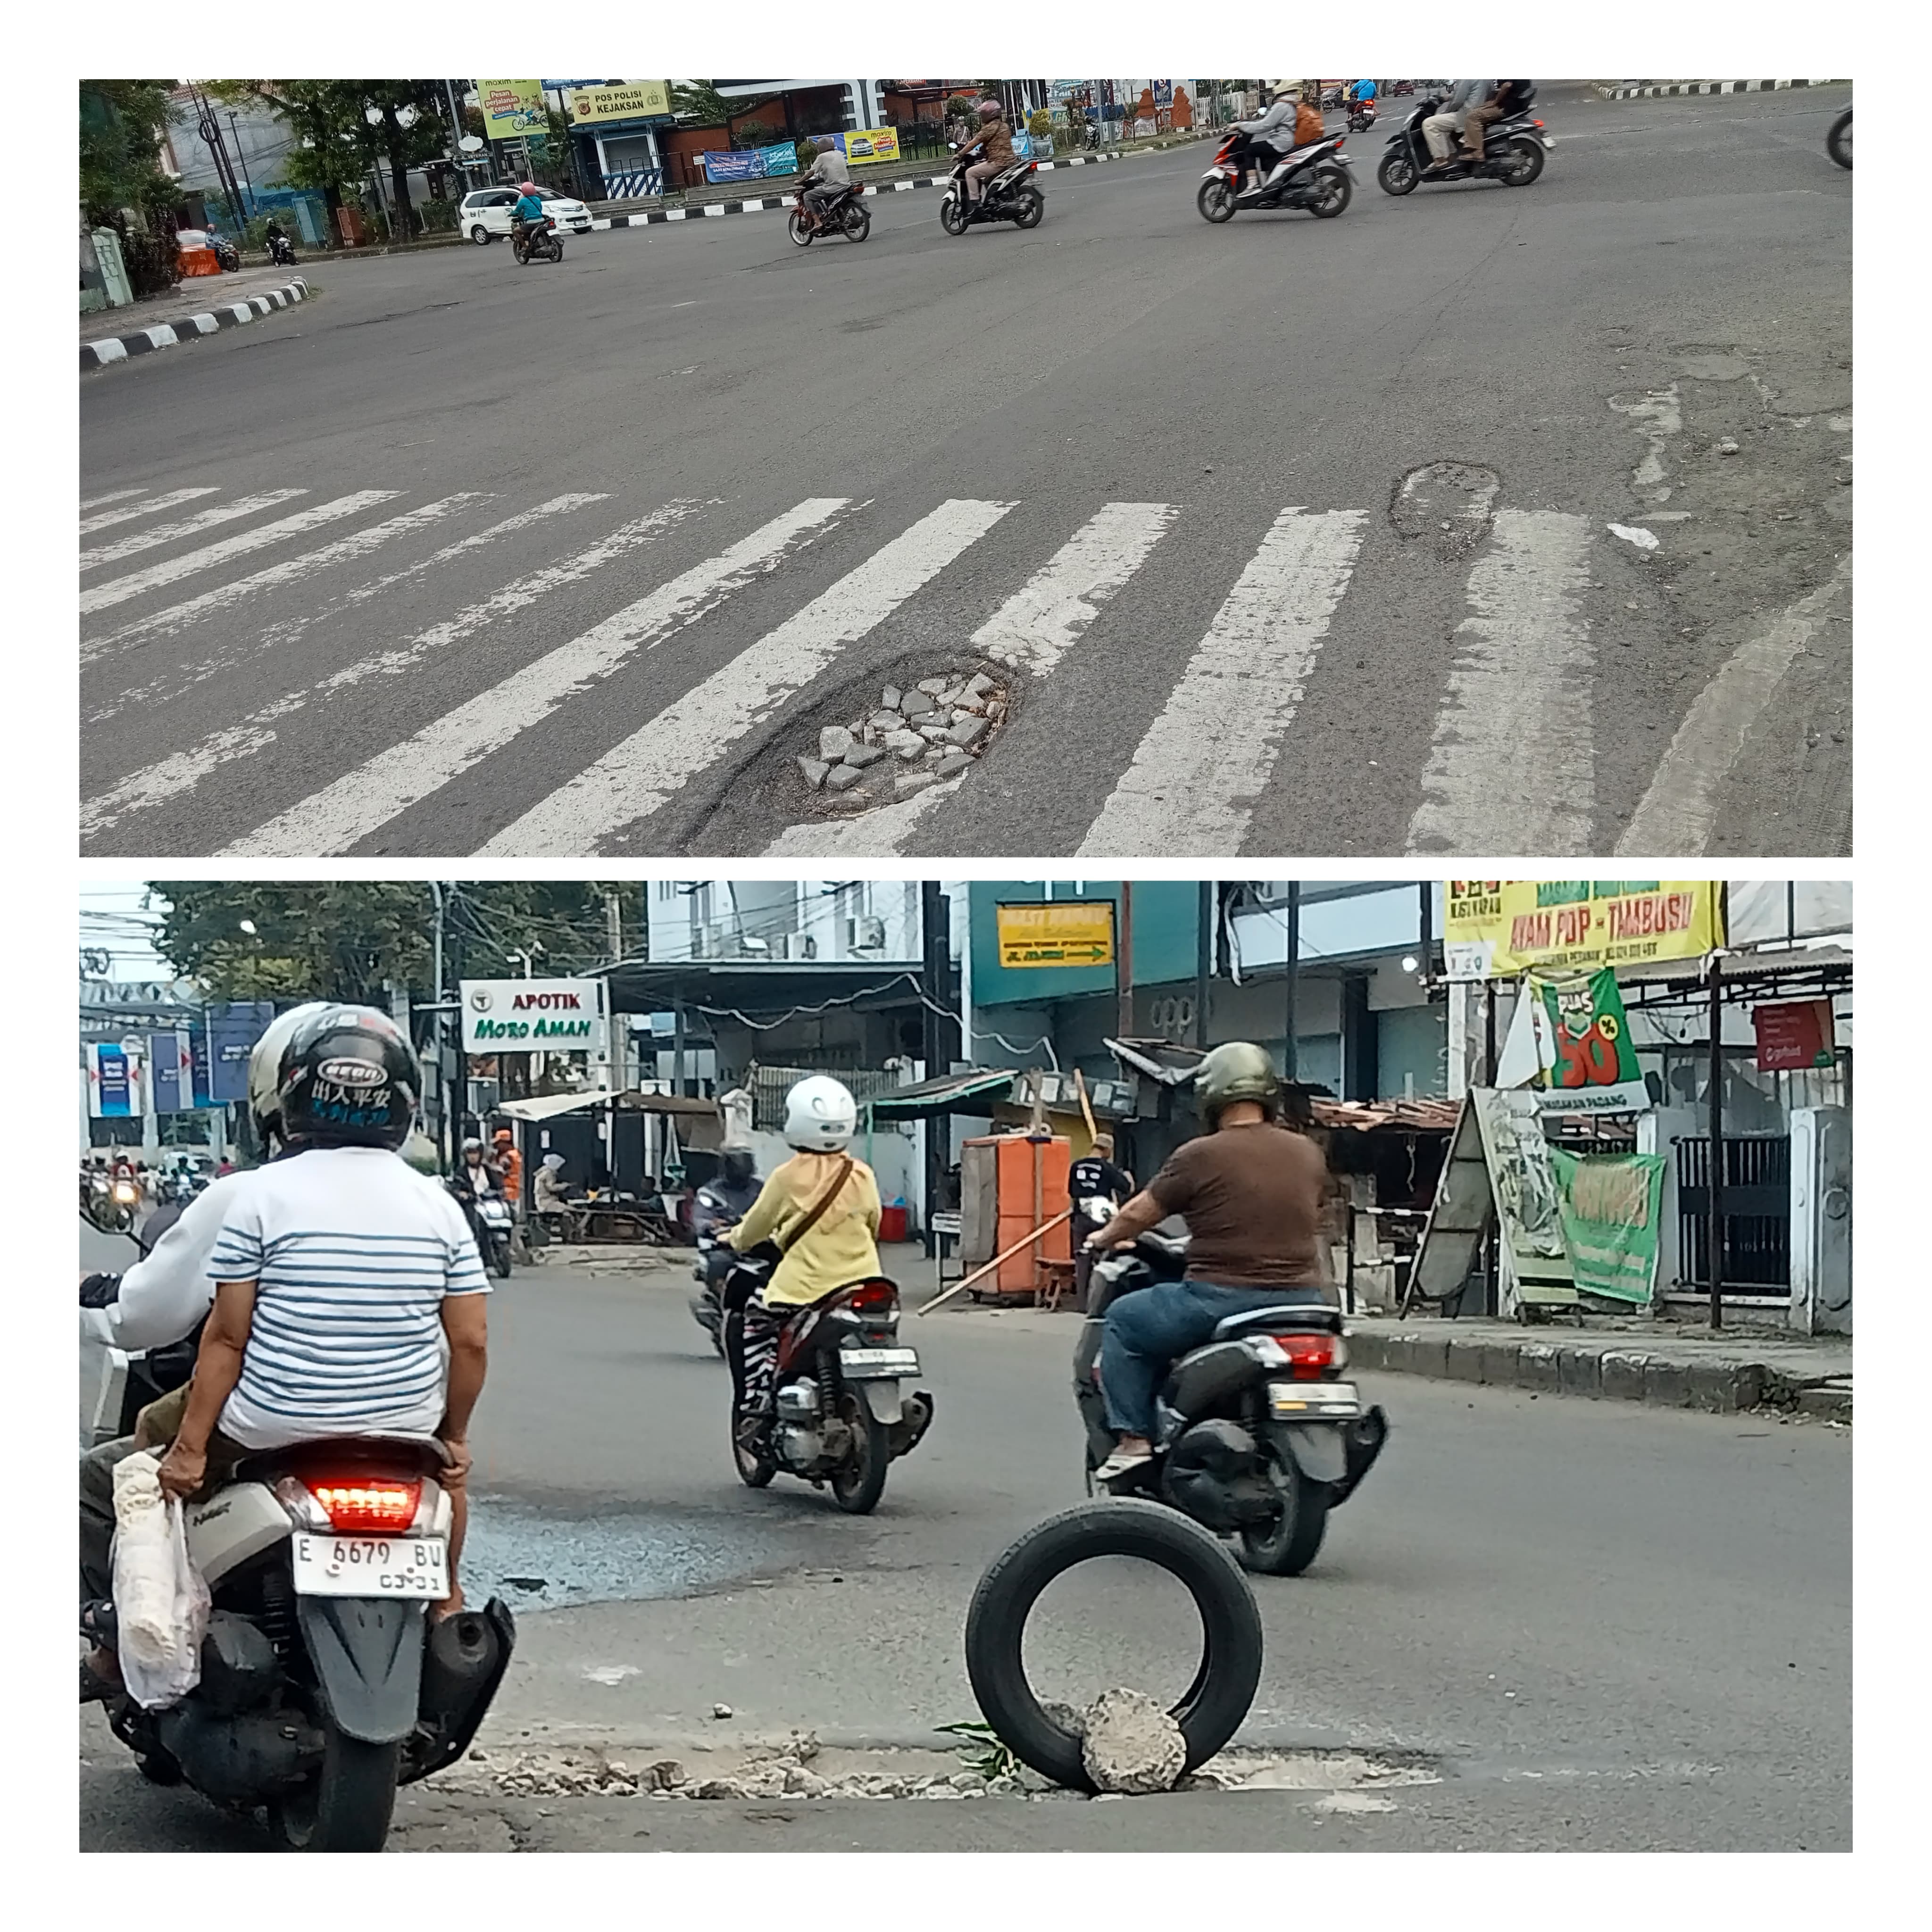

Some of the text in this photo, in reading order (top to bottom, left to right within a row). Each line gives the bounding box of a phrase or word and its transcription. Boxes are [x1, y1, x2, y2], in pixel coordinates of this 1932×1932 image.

[486, 97, 518, 108] perjalanan
[595, 94, 612, 102] POS
[615, 90, 642, 100] POLISI
[494, 105, 512, 113] cepat
[597, 100, 644, 114] KEJAKSAN
[1510, 912, 1551, 952] AYAM
[1556, 906, 1591, 946] POP
[511, 993, 581, 1010] APOTIK
[533, 1016, 591, 1039] AMAN
[300, 1539, 441, 1567] E 6679 BU
